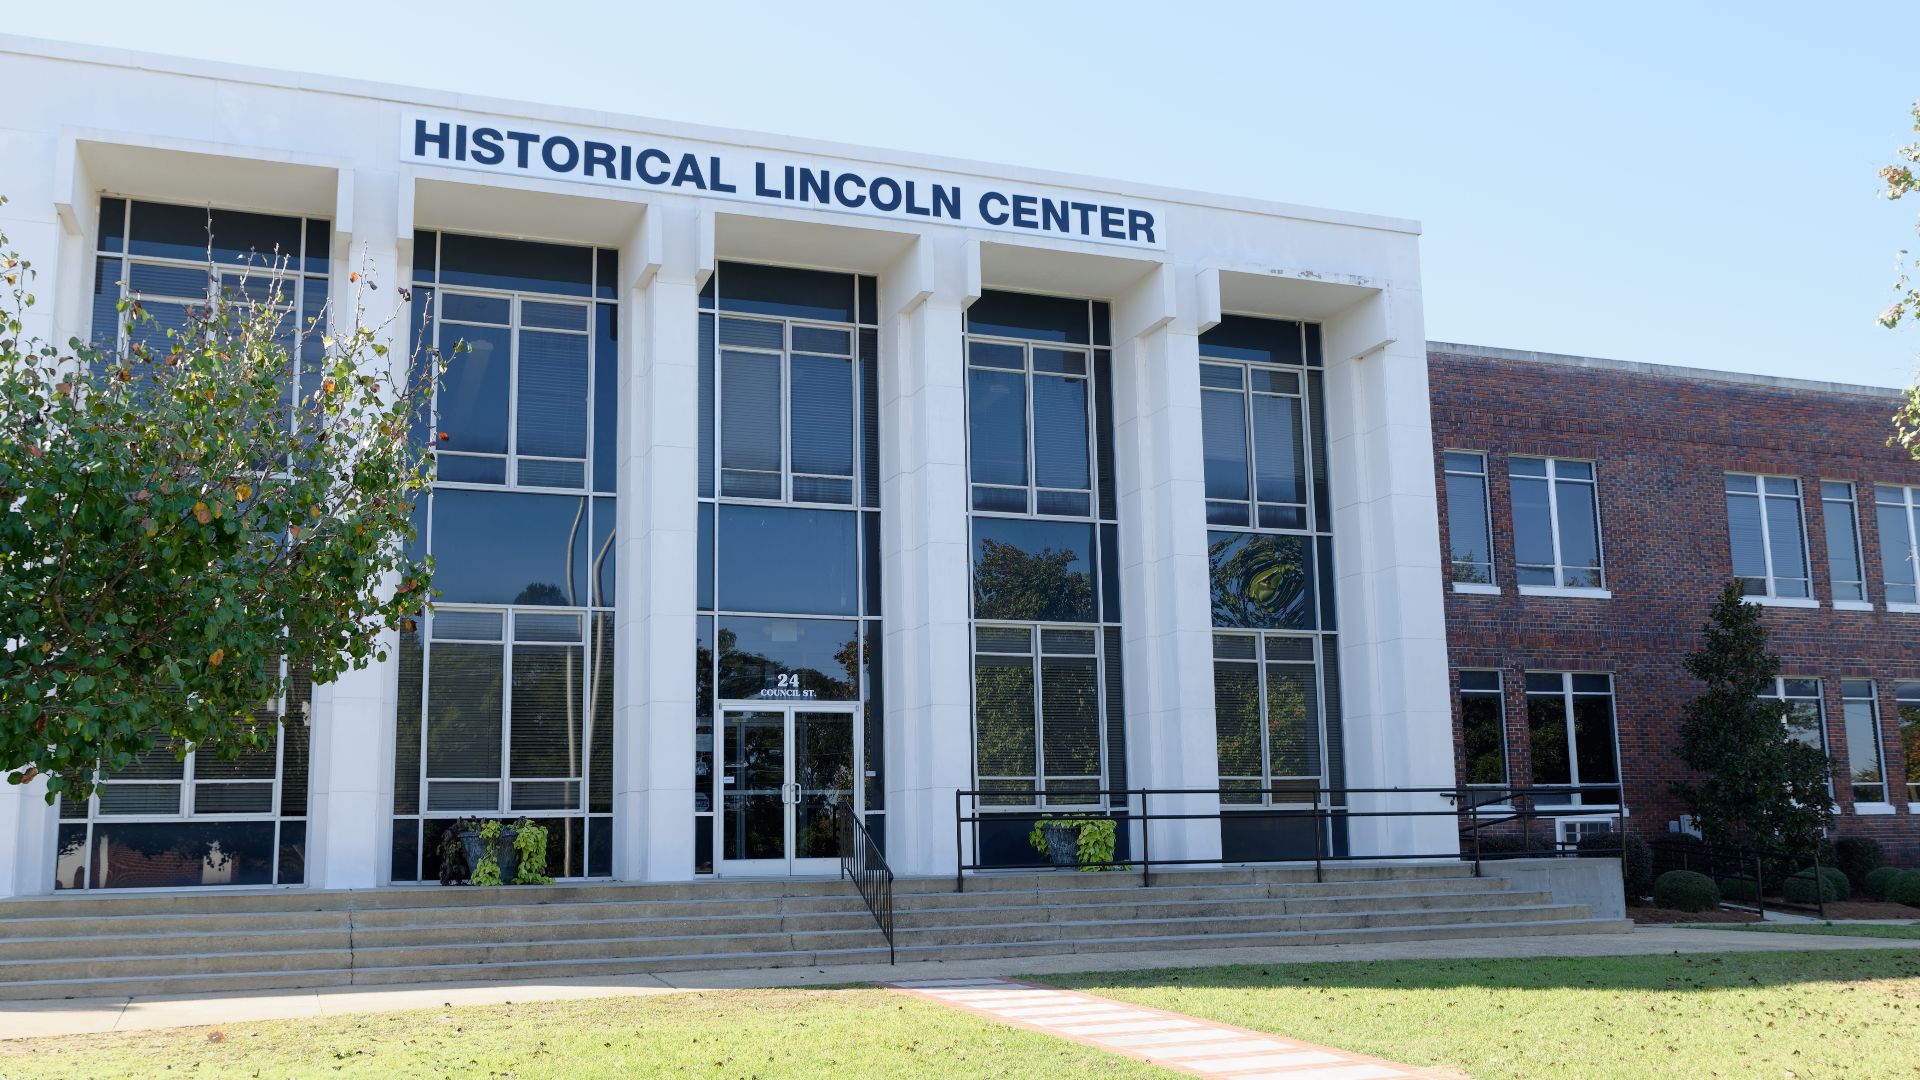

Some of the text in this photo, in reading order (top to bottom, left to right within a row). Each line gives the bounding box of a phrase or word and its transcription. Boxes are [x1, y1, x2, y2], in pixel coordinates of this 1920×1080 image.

[414, 119, 1156, 244] HISTORICAL LINCOLN CENTER
[777, 673, 800, 688] 24
[760, 688, 817, 697] COUNCIL ST.
